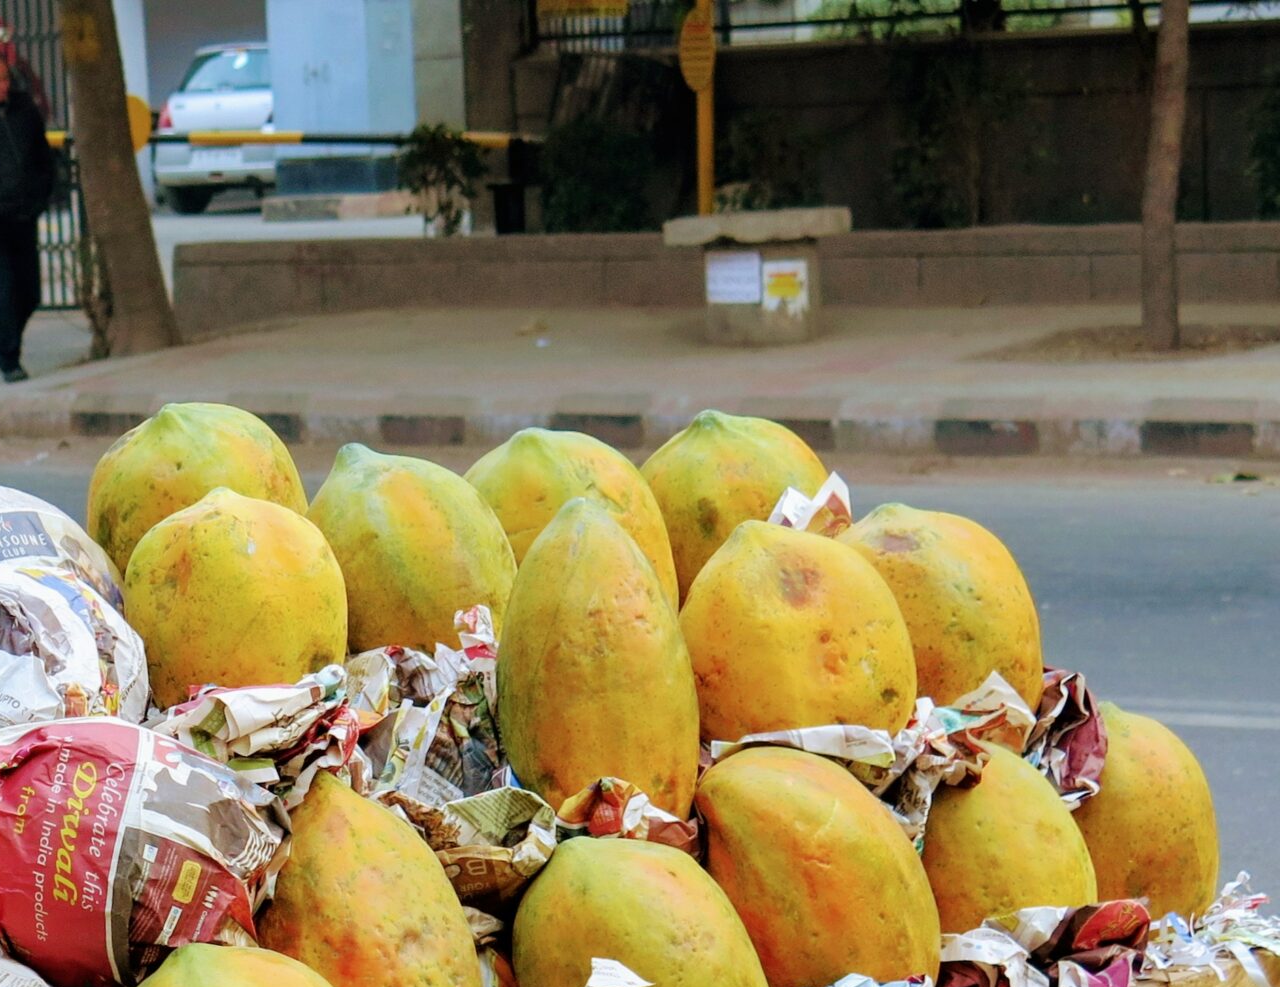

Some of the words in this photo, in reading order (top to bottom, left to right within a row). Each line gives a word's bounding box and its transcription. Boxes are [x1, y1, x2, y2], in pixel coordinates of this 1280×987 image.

[1, 546, 26, 558] CLUB
[51, 748, 71, 794] made
[13, 785, 35, 835] from
[45, 797, 63, 814] in
[89, 762, 126, 858] Celebrate
[37, 819, 57, 867] India
[52, 761, 98, 906] Diwali
[32, 870, 48, 942] products
[81, 870, 103, 912] this
